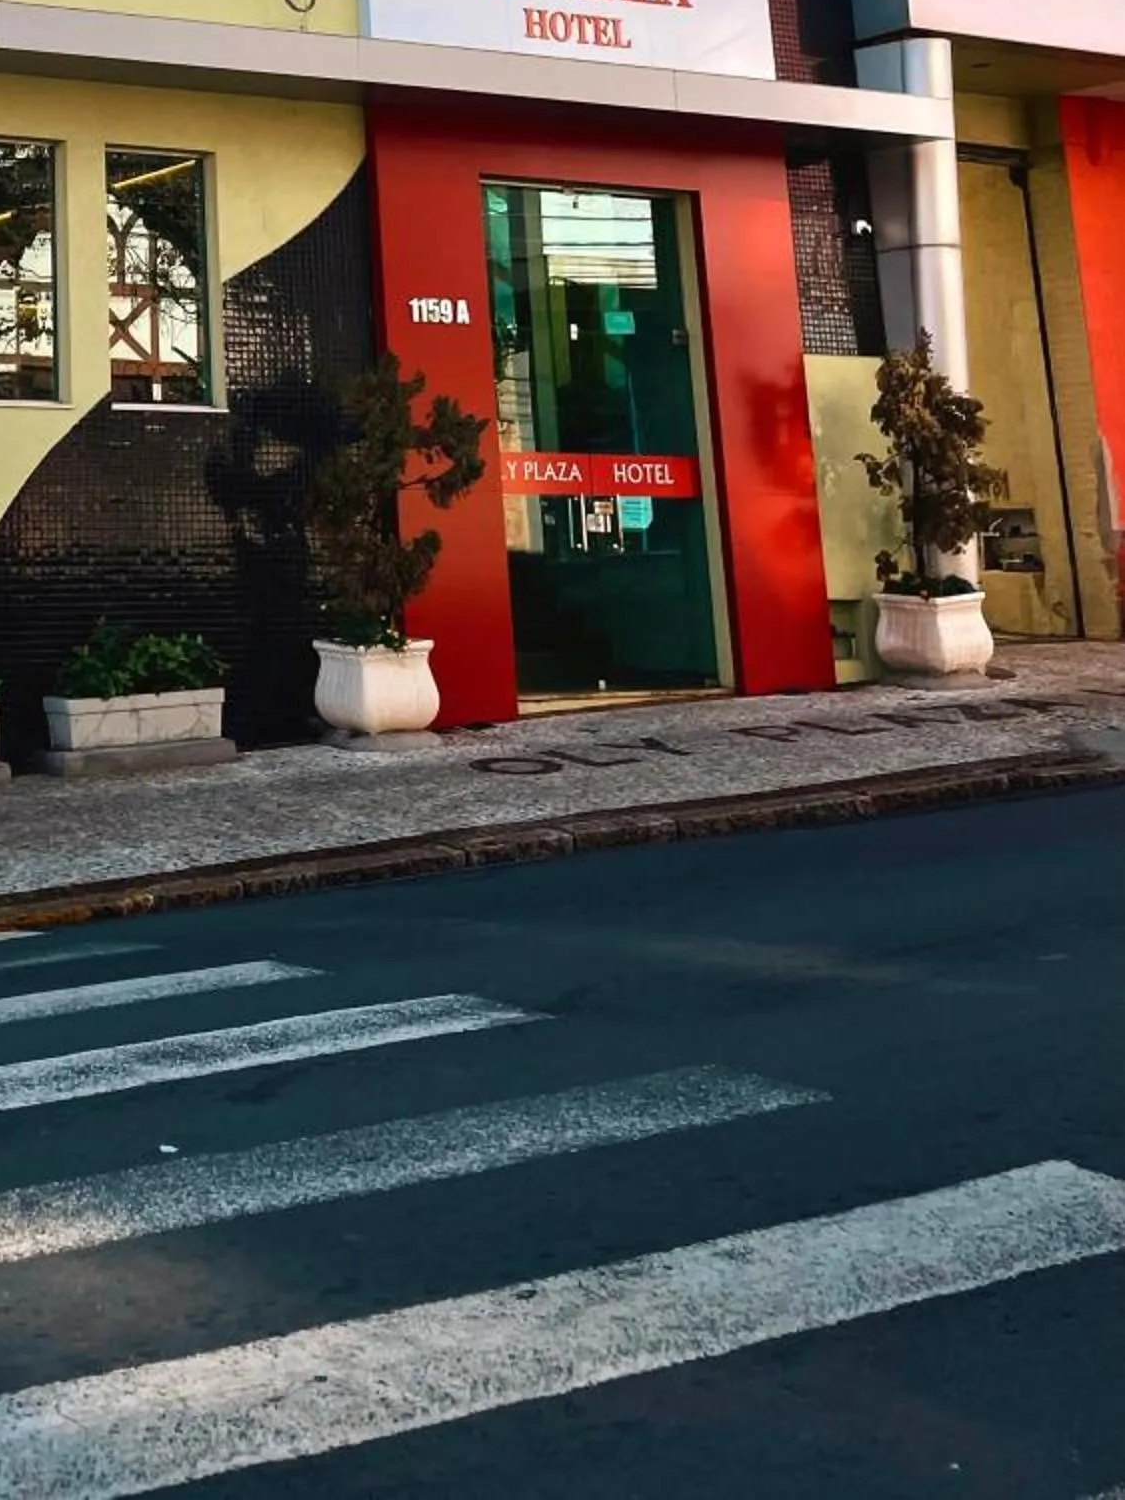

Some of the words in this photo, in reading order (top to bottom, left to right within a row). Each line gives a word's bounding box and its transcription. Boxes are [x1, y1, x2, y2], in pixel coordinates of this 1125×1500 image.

[522, 7, 632, 49] HOTEL
[408, 297, 454, 324] 1159
[456, 299, 470, 325] A
[524, 460, 583, 482] PLAZA
[613, 462, 675, 485] HOTEL
[469, 736, 695, 775] OLY
